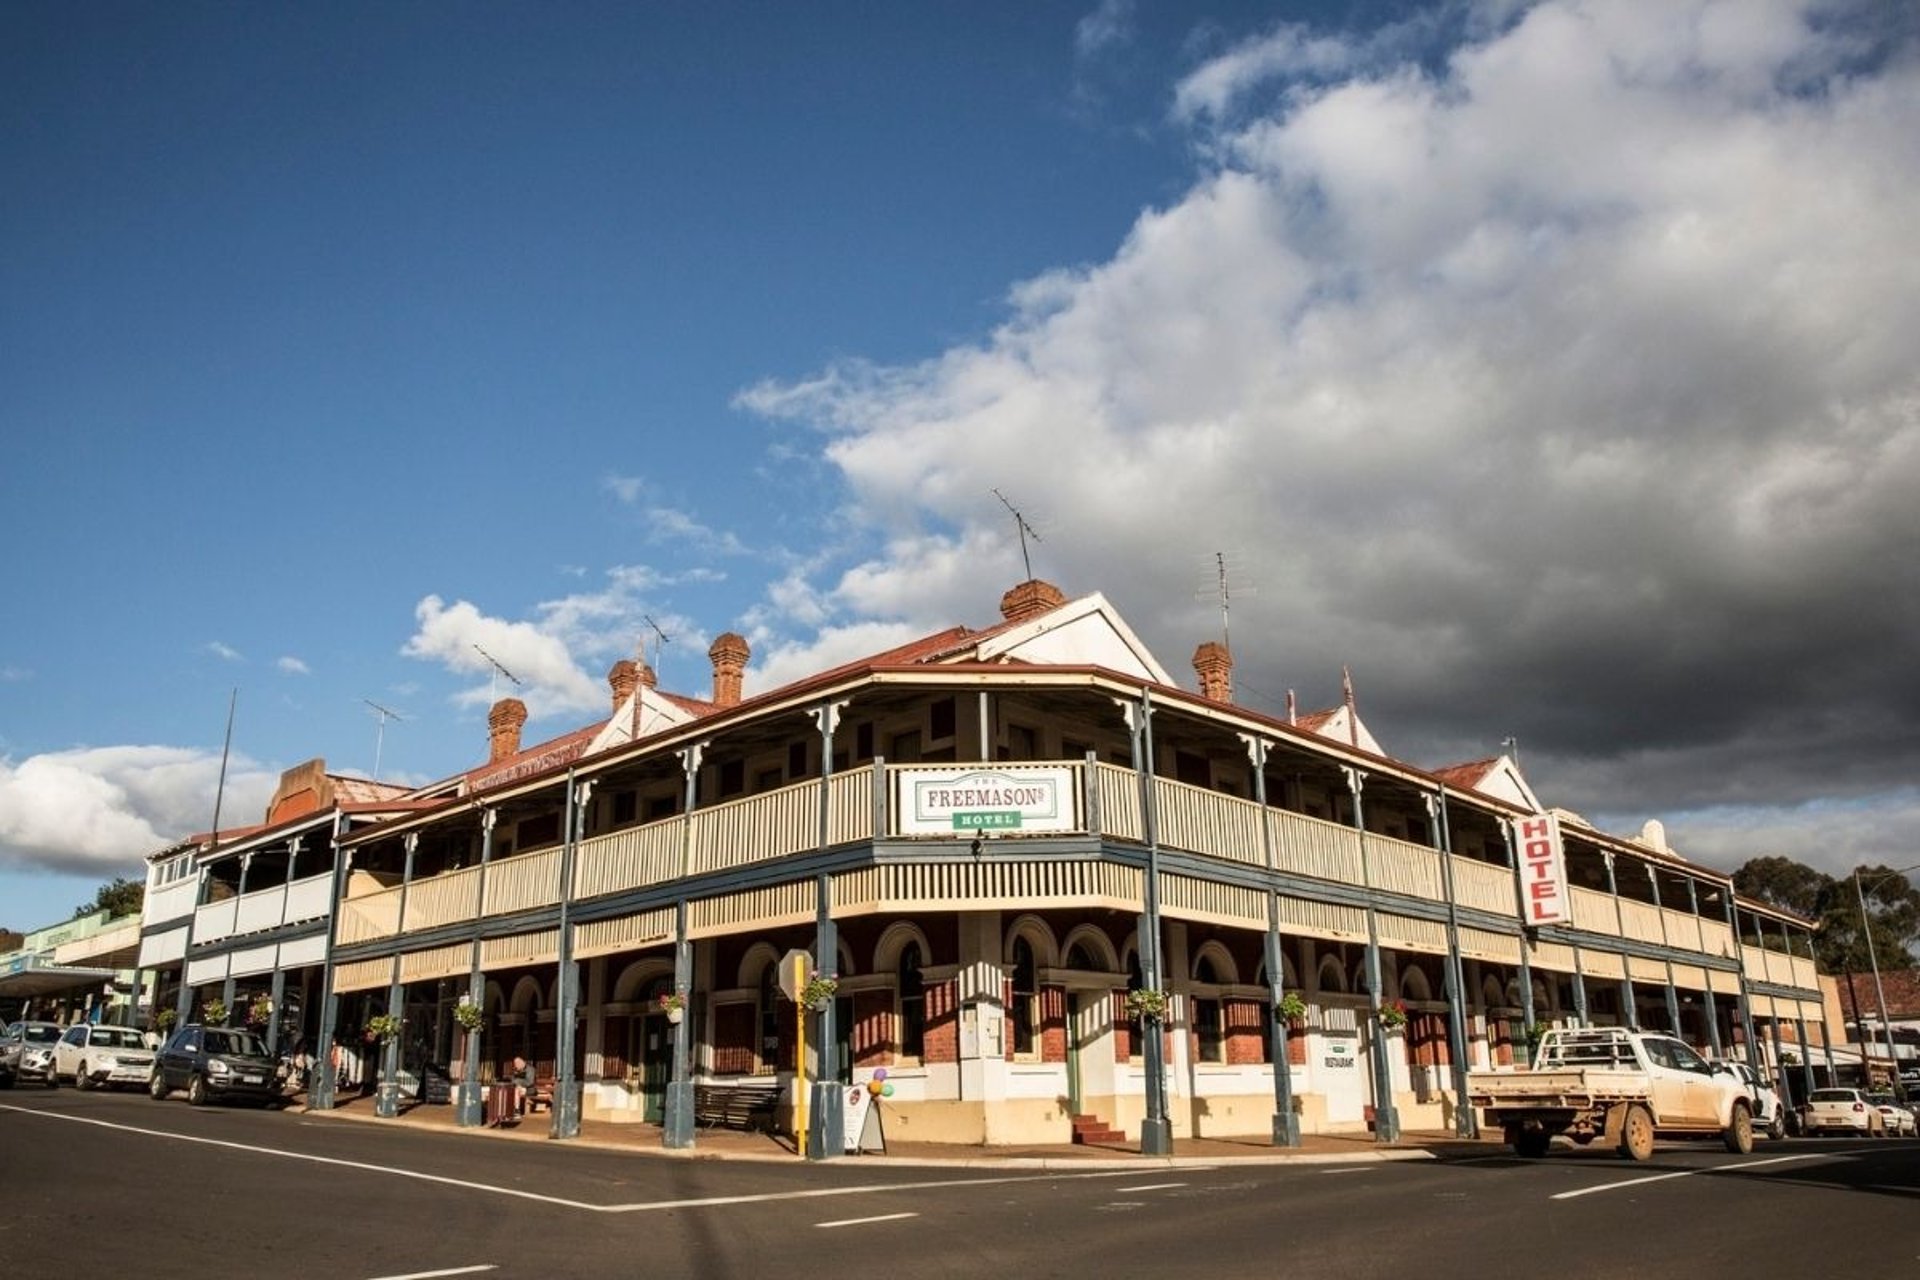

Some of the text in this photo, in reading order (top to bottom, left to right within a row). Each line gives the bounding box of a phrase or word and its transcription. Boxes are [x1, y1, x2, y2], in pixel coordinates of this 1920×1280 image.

[928, 787, 1044, 808] FREEMASONS
[962, 815, 1013, 826] HOTEL
[1523, 819, 1559, 919] HOTEL
